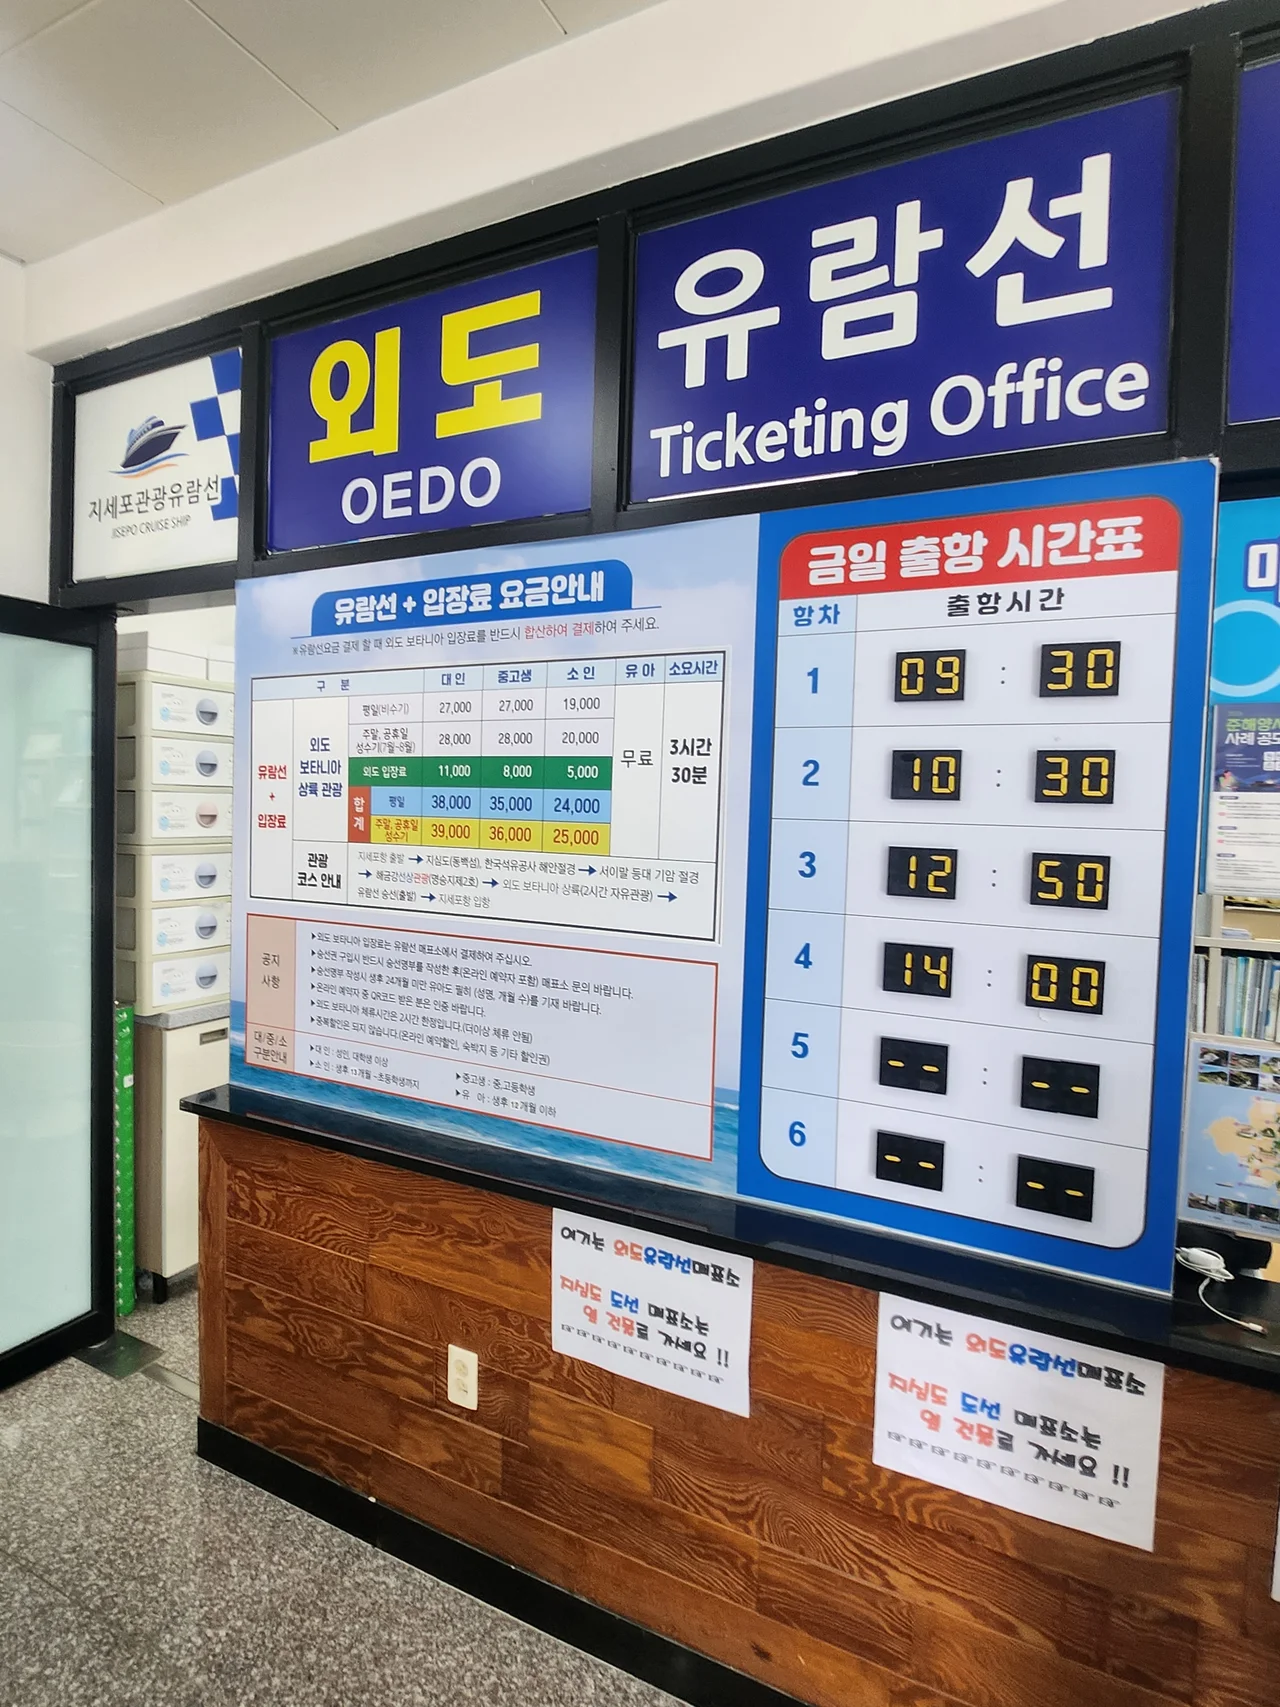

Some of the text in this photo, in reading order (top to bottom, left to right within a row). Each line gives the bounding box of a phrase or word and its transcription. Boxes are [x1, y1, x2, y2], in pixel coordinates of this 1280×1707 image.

[649, 356, 1149, 479] Ticketing Office
[88, 475, 220, 522] 지세포관광유람선
[341, 457, 502, 525] OEDO
[808, 515, 1144, 586] 금일 출항 시간표
[334, 570, 604, 626] 유람선 + 입장료 요금안내
[385, 636, 403, 649] 외도
[406, 633, 444, 647] 보타니아
[447, 629, 487, 645] 입장료를
[490, 627, 521, 641] 반드시
[524, 624, 568, 640] 합산하여
[572, 619, 617, 636] 결제하여
[621, 616, 659, 632] 주세요.
[497, 669, 532, 684] 중고생
[669, 660, 718, 676] 소요시간
[901, 648, 1115, 696] 09 30
[806, 667, 820, 694] 1
[439, 701, 472, 715] 27,000
[499, 699, 533, 713] 27,000
[563, 697, 601, 711] 19,000
[383, 728, 409, 740] 공휴일
[438, 733, 471, 746] 28,000
[498, 732, 533, 746] 28,000
[561, 731, 600, 746] 20,000
[1224, 732, 1255, 746] 사례
[309, 737, 331, 752] 외도
[669, 738, 712, 756] 3시간
[300, 760, 342, 775] 보타니아
[620, 750, 654, 768] 무료
[257, 764, 287, 780] 유람선
[363, 765, 408, 778] 외도 입장료
[438, 764, 471, 779] 11,000
[503, 765, 532, 779] 8,000
[567, 765, 599, 780] 5,000
[671, 766, 708, 784] 30분
[802, 759, 820, 787] 2
[912, 756, 1110, 798] 10 30
[298, 782, 343, 798] 상륙 관광
[388, 796, 405, 808] 평일
[431, 795, 472, 811] 38,000
[489, 796, 533, 813] 35,000
[553, 798, 600, 815] 24,000
[257, 814, 287, 829] 입장료
[394, 819, 419, 831] 공휴일
[385, 830, 409, 843] 성수기
[431, 824, 471, 840] 39,000
[489, 826, 532, 843] 36,000
[553, 829, 599, 846] 25,000
[307, 852, 329, 869] 관광
[799, 850, 817, 879] 3
[484, 859, 537, 873] 한국석유공사
[539, 861, 576, 876] 해안절경
[600, 866, 630, 880] 서이말
[631, 868, 651, 882] 등대
[654, 869, 675, 883] 기암
[678, 870, 700, 885] 절경
[908, 855, 1104, 903] 12 50
[297, 872, 342, 890] 코스 안내
[357, 887, 380, 899] 유람선
[502, 879, 520, 891] 외도
[523, 880, 559, 895] 보타니아
[610, 887, 654, 903] 자유관광)
[316, 932, 331, 943] 외도
[333, 934, 361, 946] 보타니아
[363, 937, 392, 951] 입장료는
[460, 949, 493, 963] 결제하여
[794, 942, 813, 970] 4
[261, 952, 281, 967] 공지
[261, 975, 281, 989] 사항
[362, 954, 384, 968] 반드시
[571, 980, 591, 995] 문의
[593, 983, 634, 1000] 바랍니다.
[905, 951, 1100, 1007] 14 00
[541, 996, 560, 1010] 기재
[562, 998, 602, 1016] 바랍니다.
[399, 1012, 420, 1025] 2시간
[790, 1032, 809, 1059] 5
[253, 1049, 288, 1064] 구분안내
[788, 1121, 807, 1147] 6
[561, 1226, 605, 1252] 여기는
[560, 1275, 709, 1336] 지심도 도선 매표소는
[583, 1305, 597, 1324] 옆
[606, 1311, 649, 1340] 건물로
[658, 1330, 707, 1360] 가세요
[889, 1314, 953, 1347] 여기는
[888, 1372, 1101, 1451] 지심도 도선 매표소는
[920, 1409, 941, 1432] 옆
[953, 1417, 1013, 1453] 건물로
[1028, 1441, 1097, 1479] 가세요
